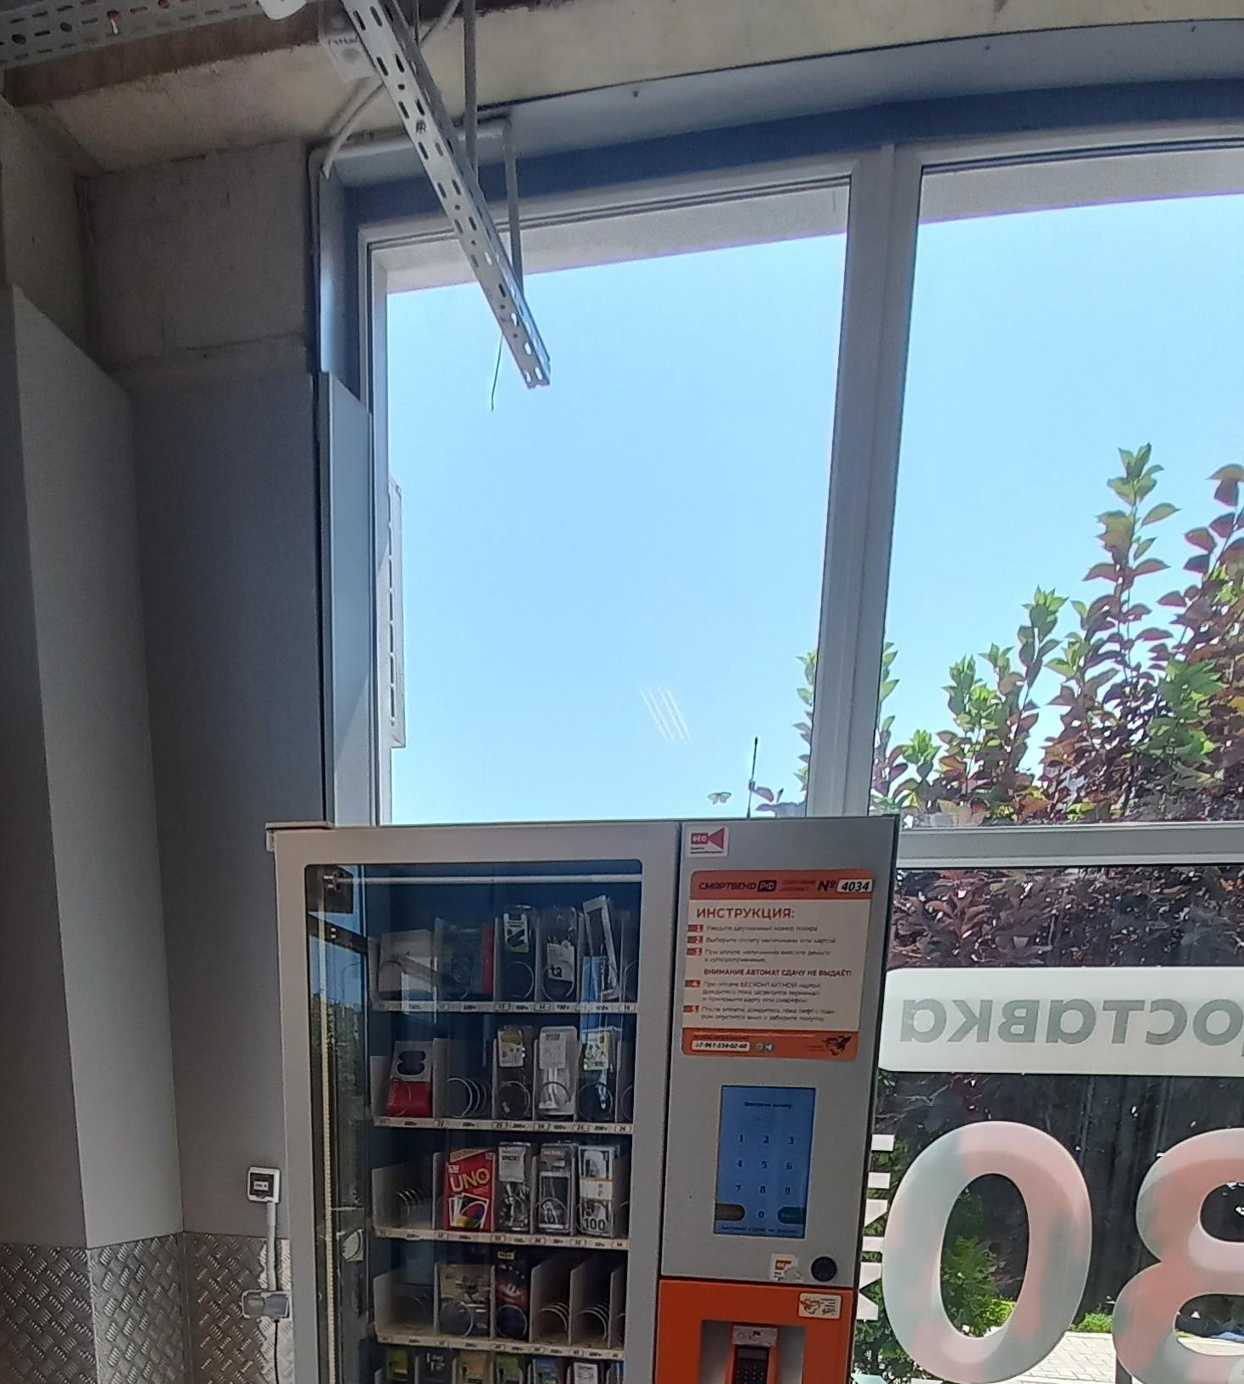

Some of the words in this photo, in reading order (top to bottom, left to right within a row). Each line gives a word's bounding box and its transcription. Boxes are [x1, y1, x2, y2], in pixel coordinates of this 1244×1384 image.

[841, 881, 869, 891] 4034
[696, 907, 795, 920] ИНСТРУКЦИЯ:
[704, 968, 744, 976] ВНИМАНИЕ
[745, 968, 780, 976] АВТОМАТ
[450, 1168, 490, 1192] UNO
[584, 1217, 606, 1231] 100
